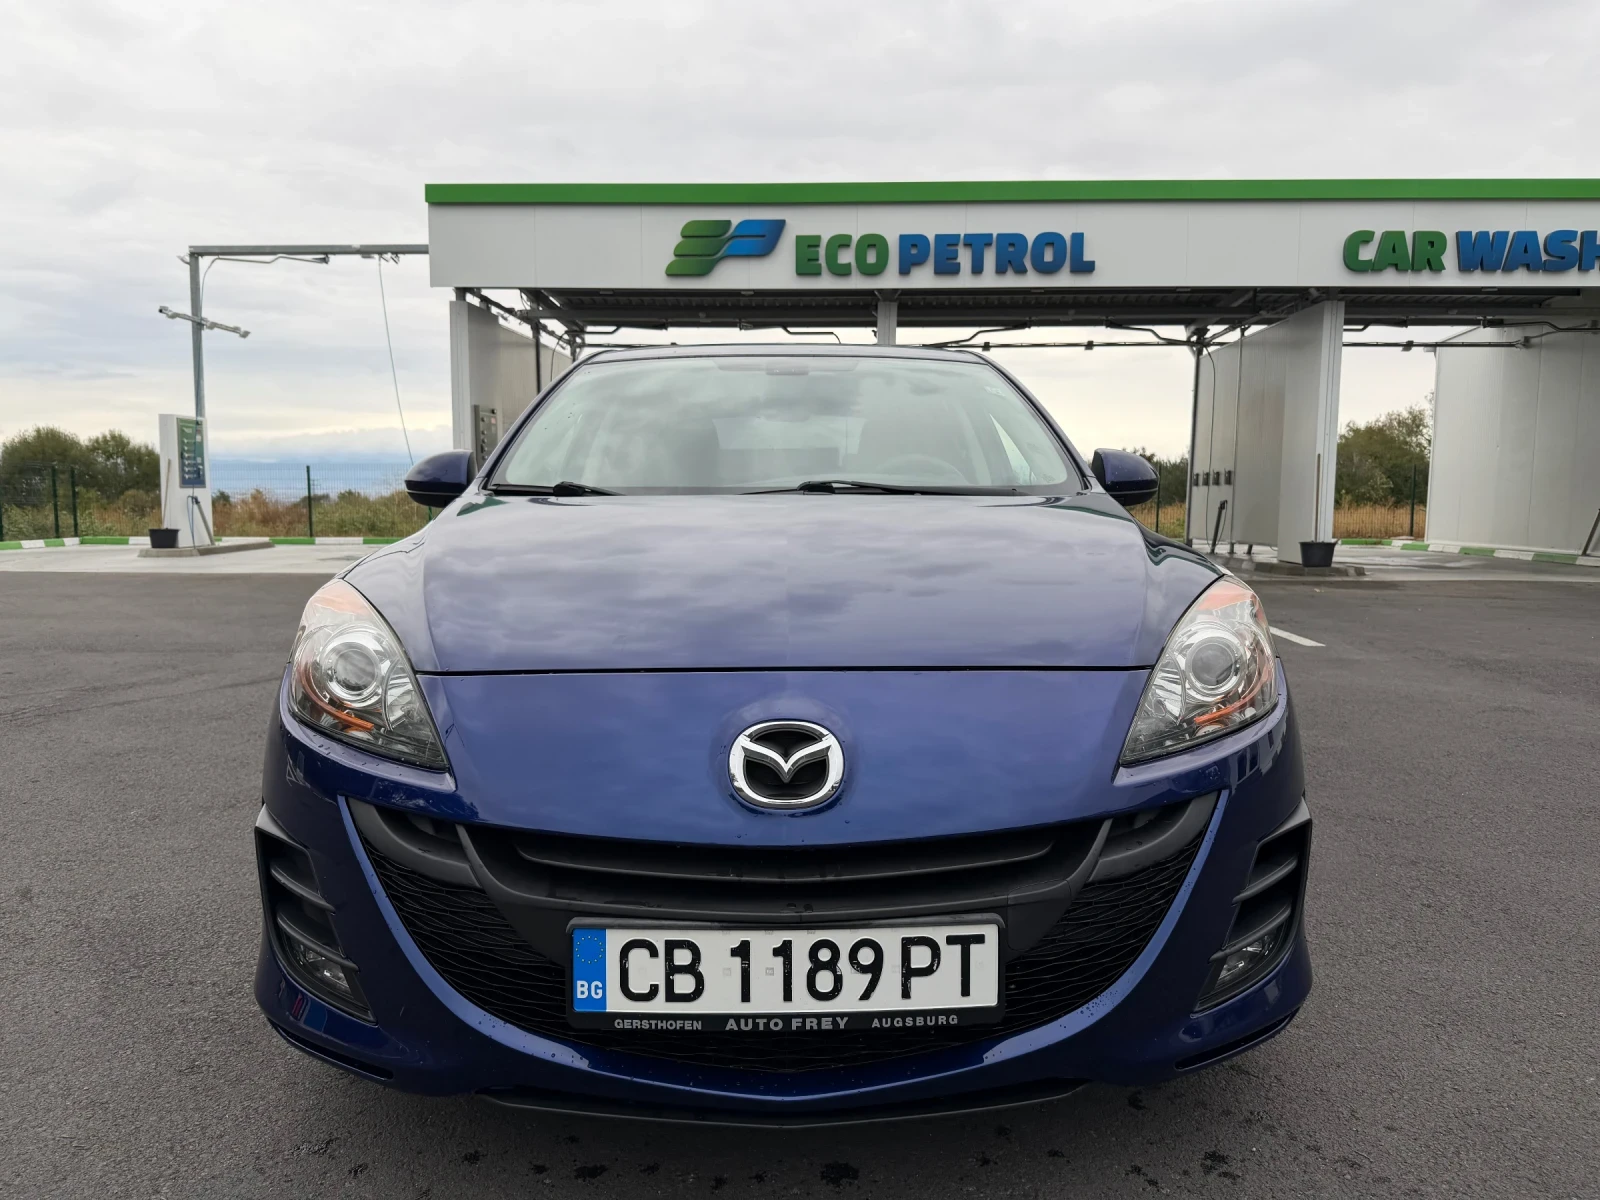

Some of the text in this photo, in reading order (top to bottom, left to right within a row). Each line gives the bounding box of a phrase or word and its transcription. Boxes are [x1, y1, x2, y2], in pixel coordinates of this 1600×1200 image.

[1343, 229, 1448, 272] CAR
[576, 980, 604, 1000] BG
[614, 1014, 959, 1031] GERSTHOFEN AUTO FREY AUGSBURG
